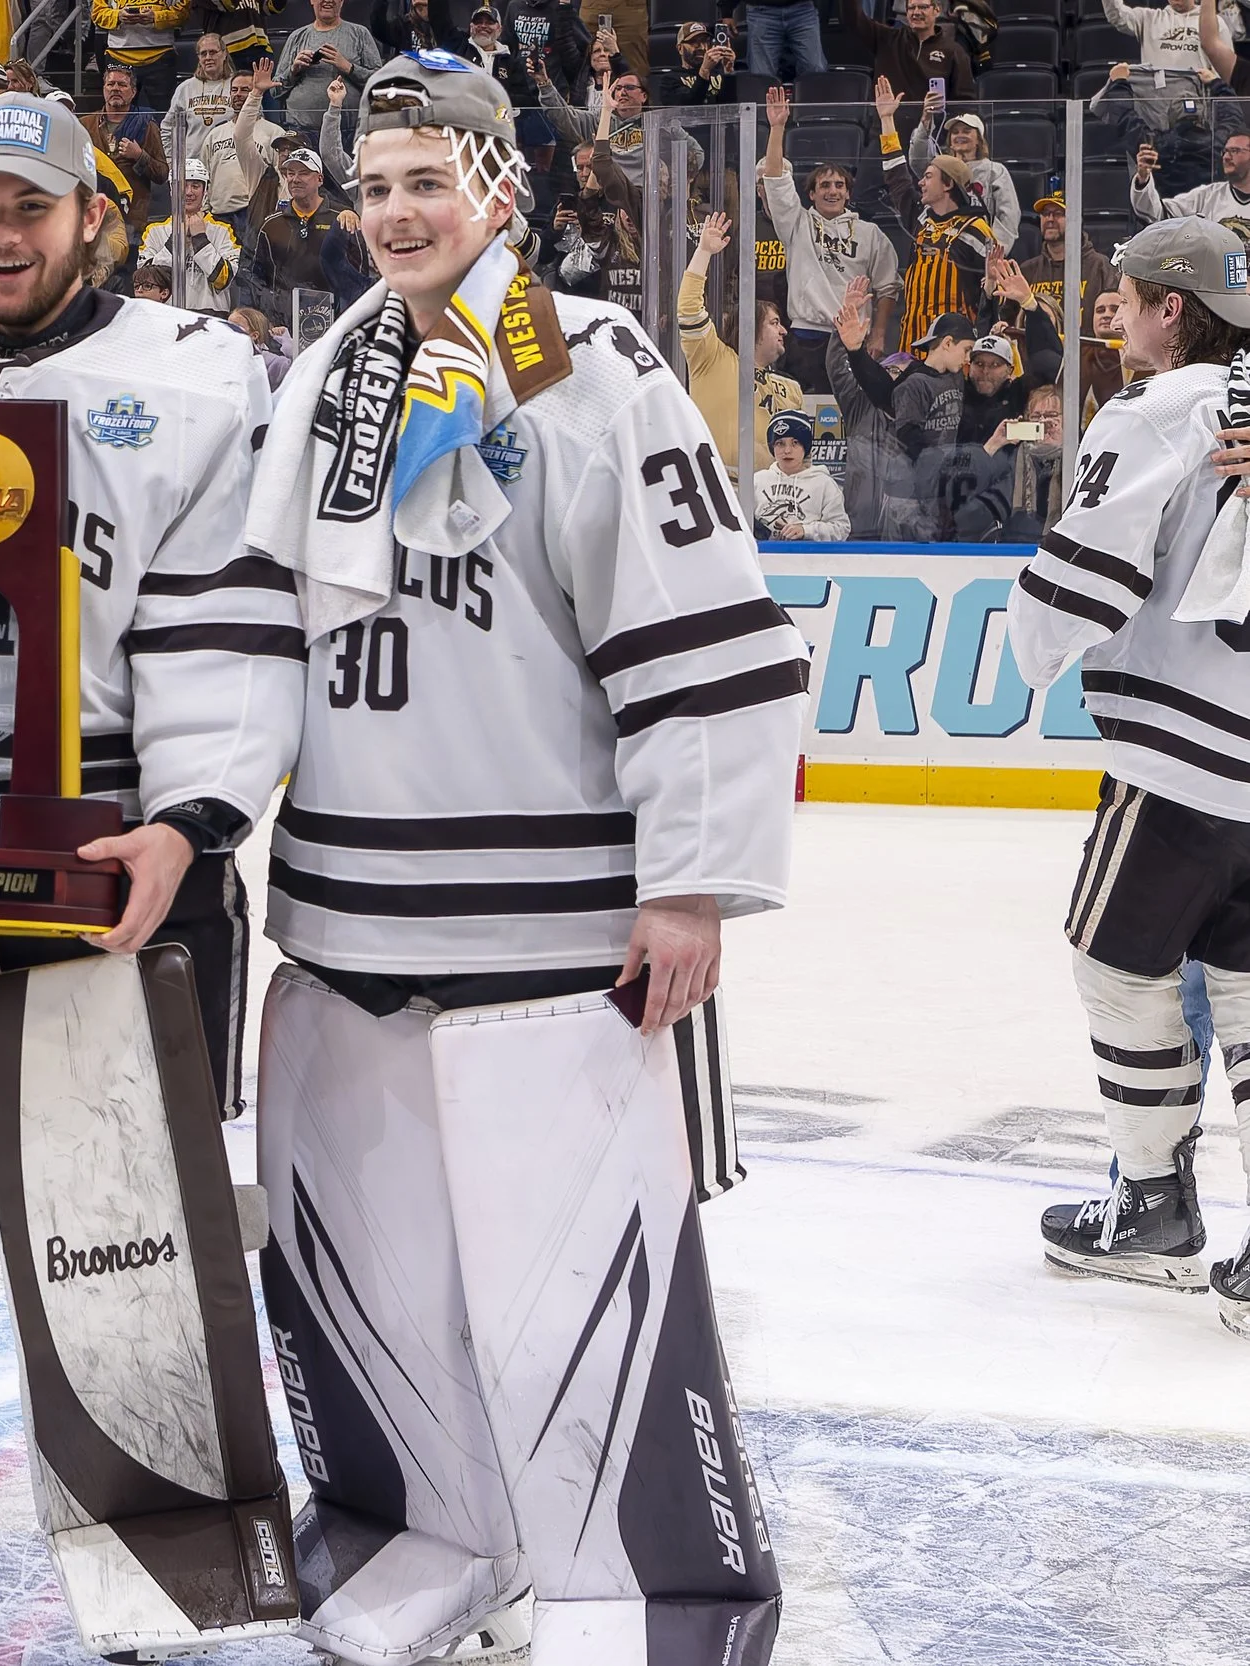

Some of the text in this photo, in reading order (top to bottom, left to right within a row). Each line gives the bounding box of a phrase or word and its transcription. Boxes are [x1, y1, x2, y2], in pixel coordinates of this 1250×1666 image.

[514, 20, 551, 34] FROZEN
[213, 94, 232, 107] MICHIGA
[754, 240, 786, 256] OCKE
[609, 268, 642, 286] WEST
[608, 290, 642, 310] MICHI
[92, 415, 153, 430] FROZEN FOUR
[345, 348, 404, 500] FROZEN
[819, 416, 839, 424] NCAA
[810, 446, 837, 461] ZEN
[770, 482, 803, 498] WMU
[328, 617, 409, 712] 30
[46, 1232, 179, 1283] Broncos
[271, 1323, 330, 1484] BAUER
[684, 1387, 747, 1576] BAUER
[292, 1514, 316, 1543] PRINT
